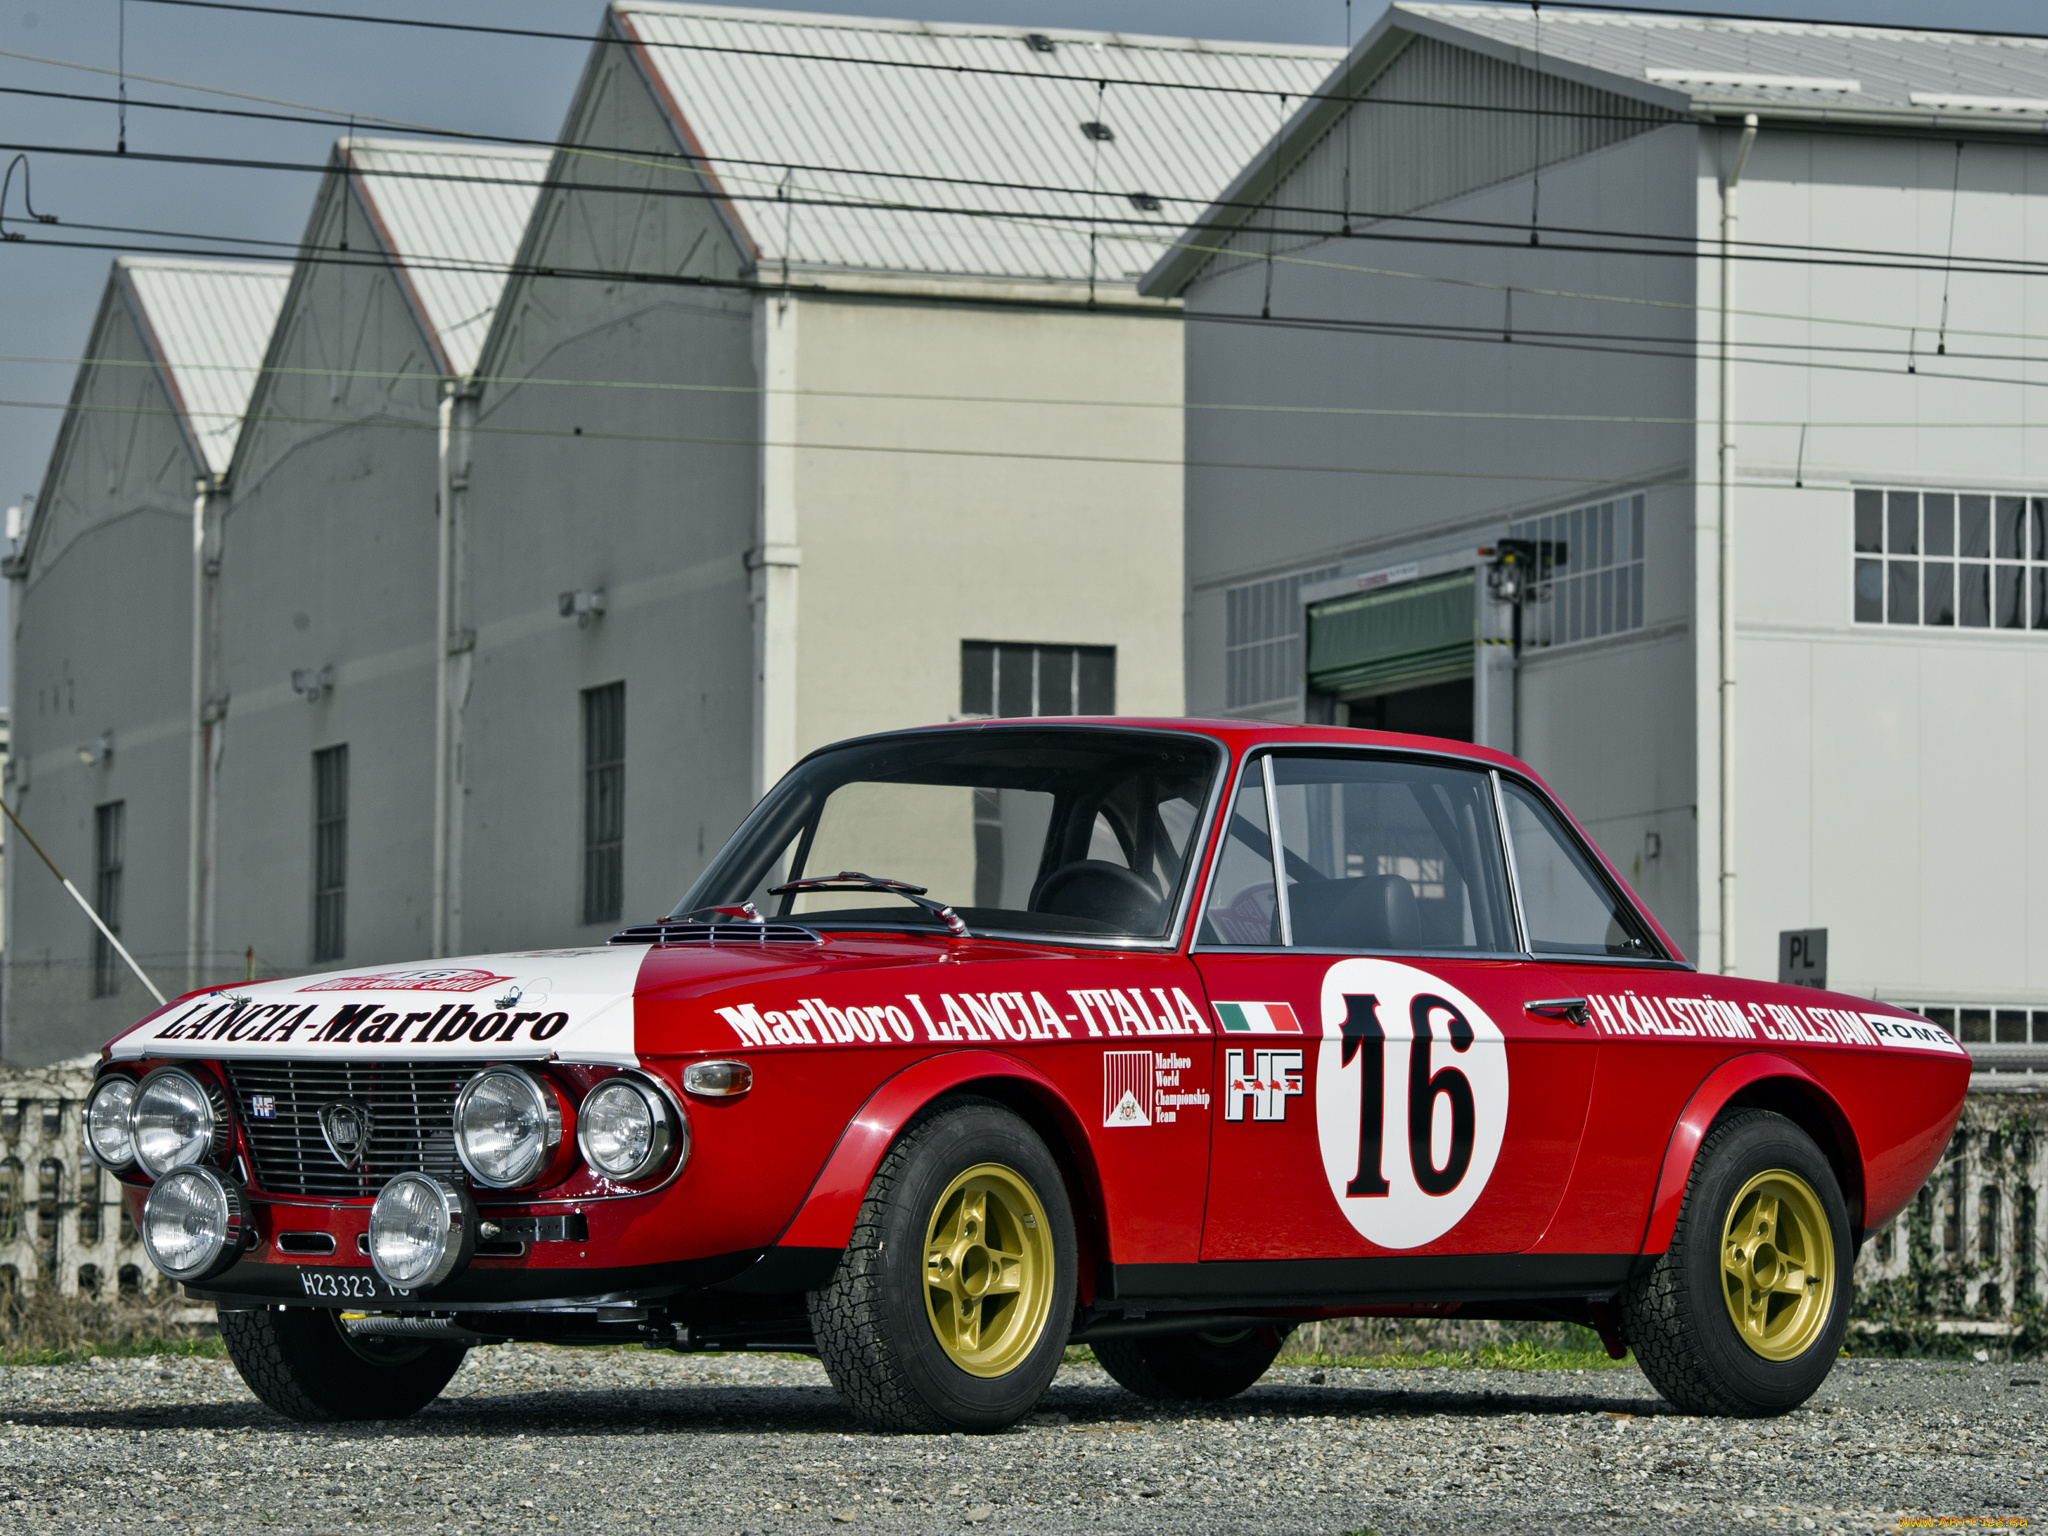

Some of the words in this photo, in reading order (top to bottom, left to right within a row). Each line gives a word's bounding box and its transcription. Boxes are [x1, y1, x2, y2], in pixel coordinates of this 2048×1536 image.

[1790, 936, 1815, 969] PL
[153, 1003, 570, 1044] LANCIA-Marlboro
[715, 999, 914, 1048] Marlboro
[905, 987, 1212, 1041] LANCIA-ITALIA
[1870, 1021, 1955, 1046] ROME
[1155, 1053, 1191, 1069] Marlboro
[1155, 1070, 1179, 1087] World
[1225, 1049, 1303, 1122] HF
[252, 1097, 274, 1116] HF
[1155, 1088, 1210, 1110] Championship
[1338, 993, 1476, 1198] 16
[1156, 1107, 1176, 1123] Team
[301, 1273, 375, 1297] H23323
